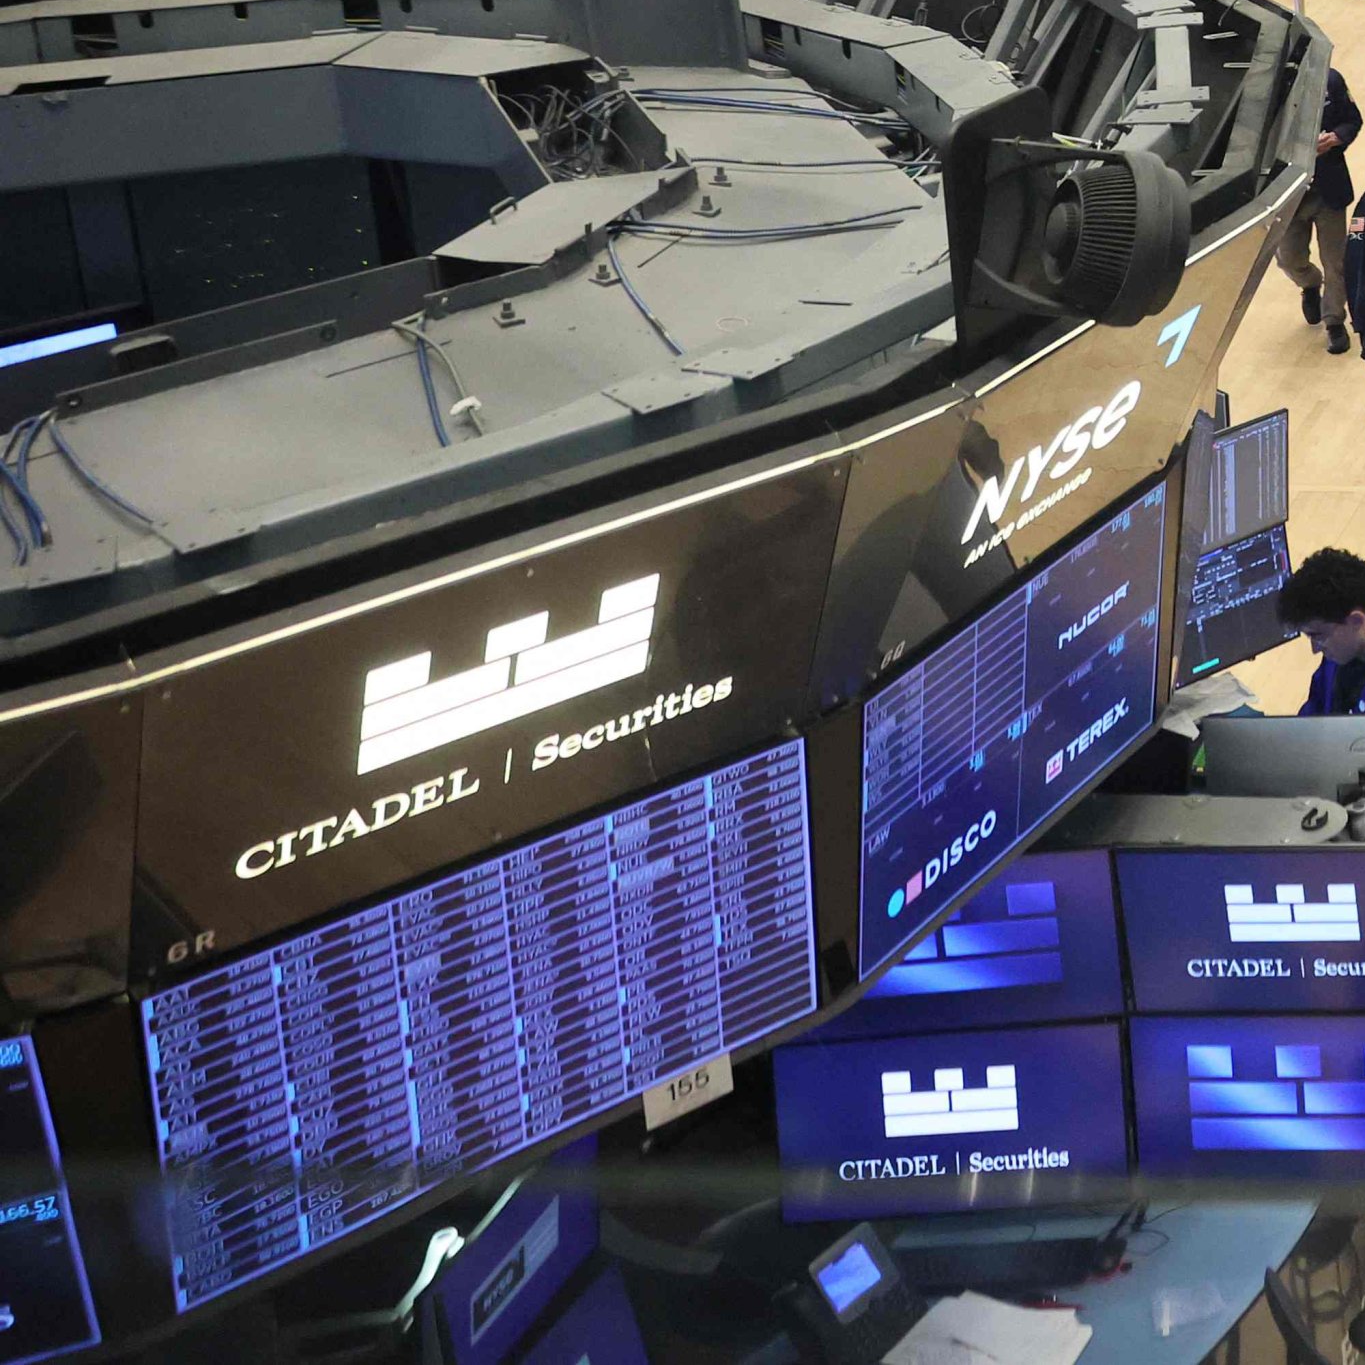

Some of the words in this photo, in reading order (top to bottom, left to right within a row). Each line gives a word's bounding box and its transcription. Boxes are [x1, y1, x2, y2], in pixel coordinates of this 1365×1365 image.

[960, 379, 1141, 545] NYSE
[963, 546, 987, 569] AN
[1014, 467, 1093, 531] EXCHANGE
[1057, 580, 1129, 650] NUCOR
[1066, 697, 1128, 762] TEREX
[233, 766, 480, 881] CITADEL
[531, 676, 734, 772] Securities
[867, 824, 891, 855] LAW
[924, 809, 997, 889] DISCO
[1186, 957, 1291, 979] CITADEL
[838, 1154, 946, 1182] CITADEL
[968, 1147, 1070, 1175] Securities
